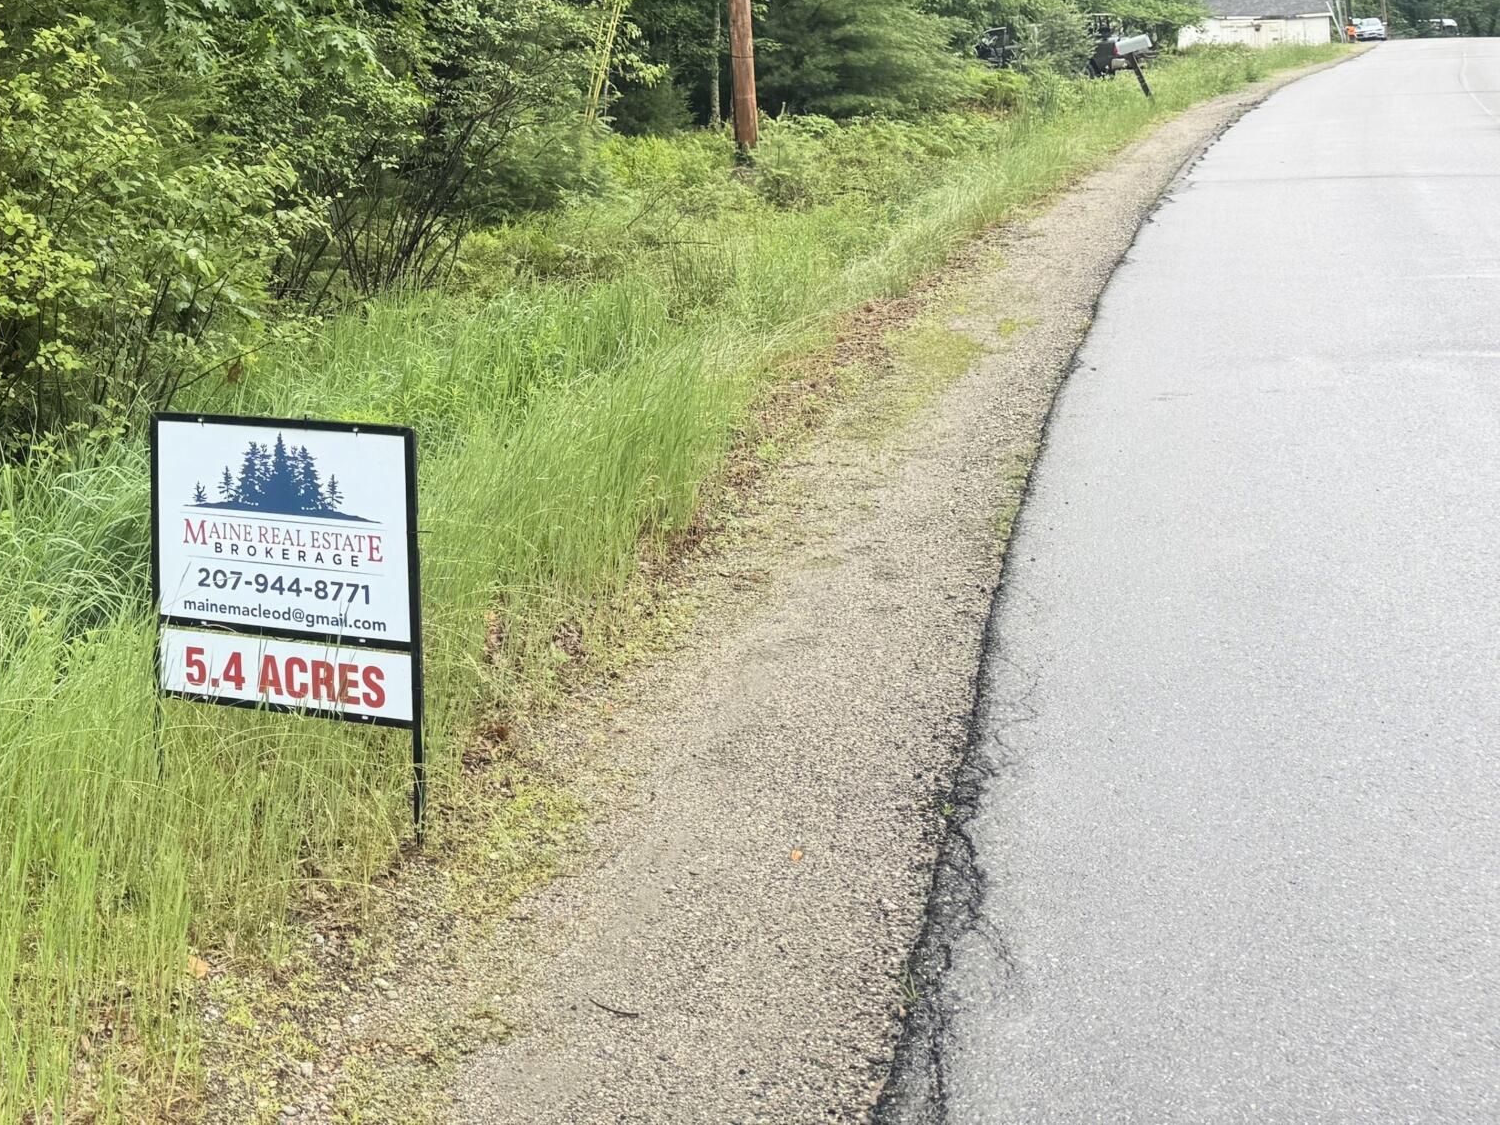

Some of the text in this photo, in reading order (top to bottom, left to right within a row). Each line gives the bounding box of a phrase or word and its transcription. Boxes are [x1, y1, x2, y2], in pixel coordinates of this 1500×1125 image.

[183, 518, 383, 562] MAINE REAL ESTATE
[214, 542, 359, 567] BROKERAGE
[198, 567, 370, 605] 207-944-8771
[183, 598, 387, 633] mainemacleod@gmail.com
[185, 646, 386, 709] 5.4 ACRES
